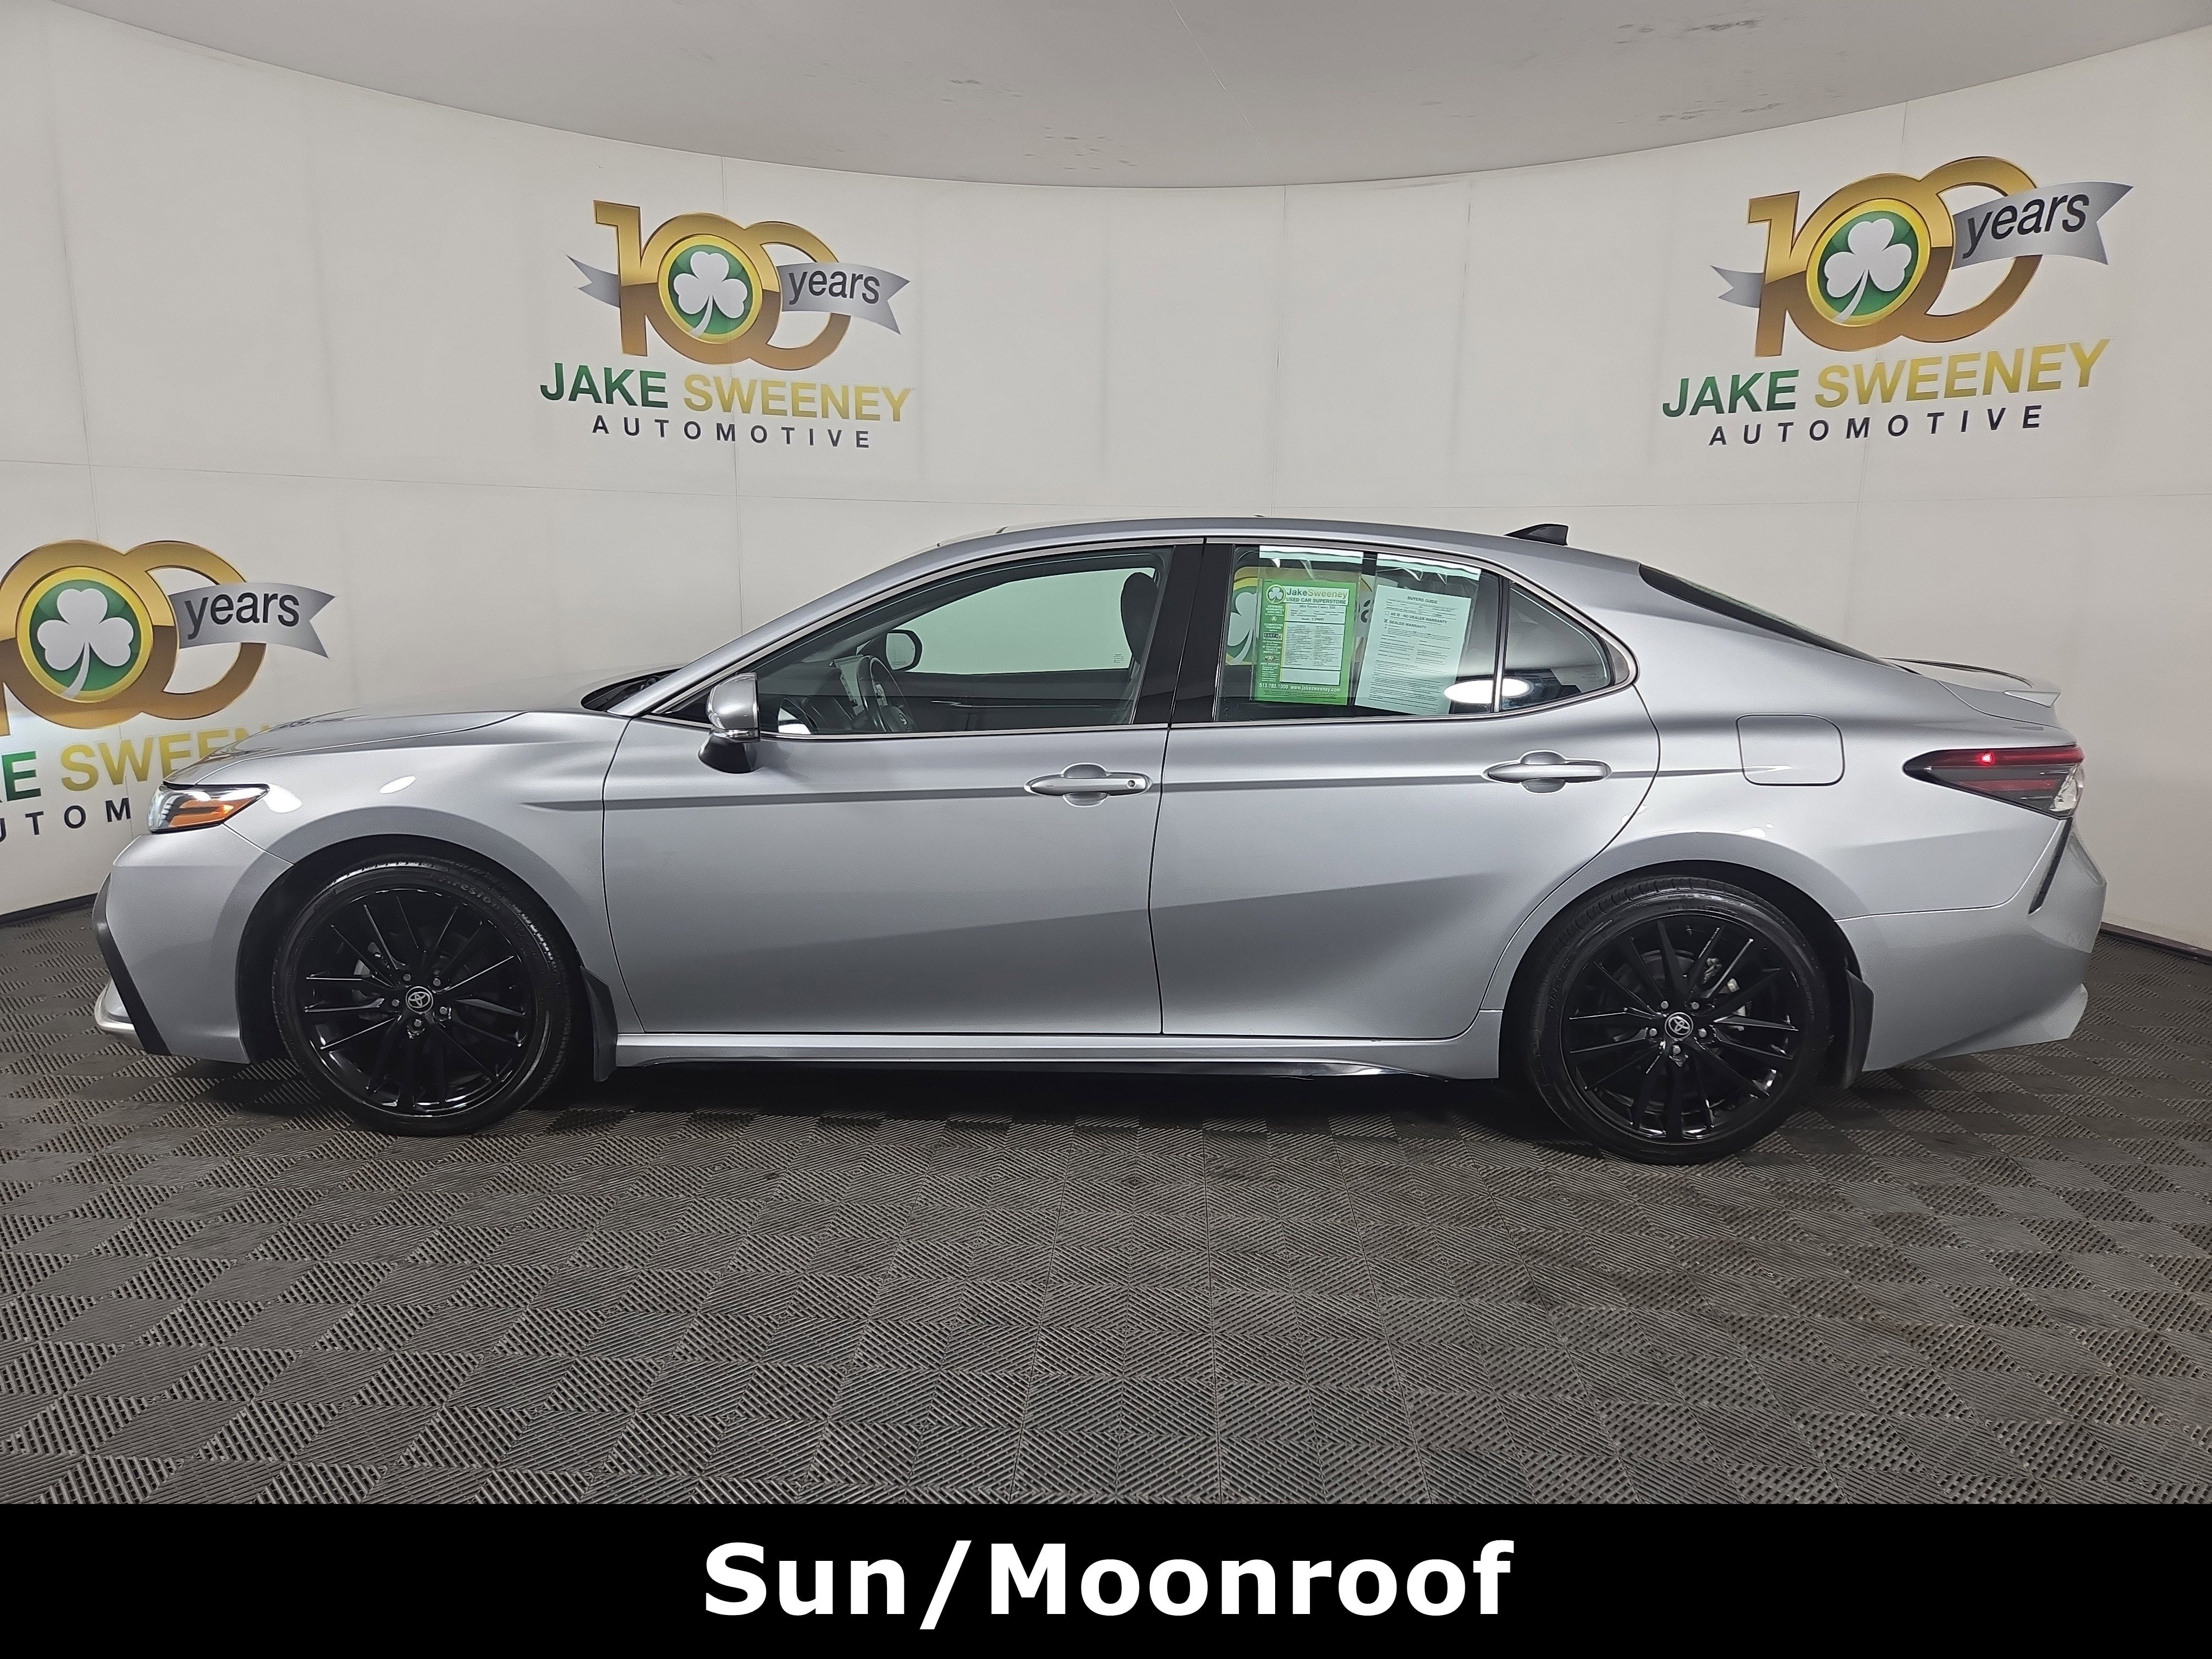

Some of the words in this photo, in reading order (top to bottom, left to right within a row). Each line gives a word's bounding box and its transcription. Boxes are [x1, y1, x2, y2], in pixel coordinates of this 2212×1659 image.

[594, 200, 852, 371] 100
[788, 271, 880, 305] years
[1747, 156, 2044, 358] 100
[1963, 192, 2090, 259] years
[539, 362, 668, 409] JAKE
[684, 373, 912, 422] SWEENEY
[1662, 369, 1800, 417] JAKE
[1815, 338, 2112, 408] SWEENEY
[592, 415, 869, 448] AUTOMOTIVE
[1708, 405, 2043, 446] AUTOMOTIVE
[0, 539, 266, 736] 00
[184, 591, 300, 640] years
